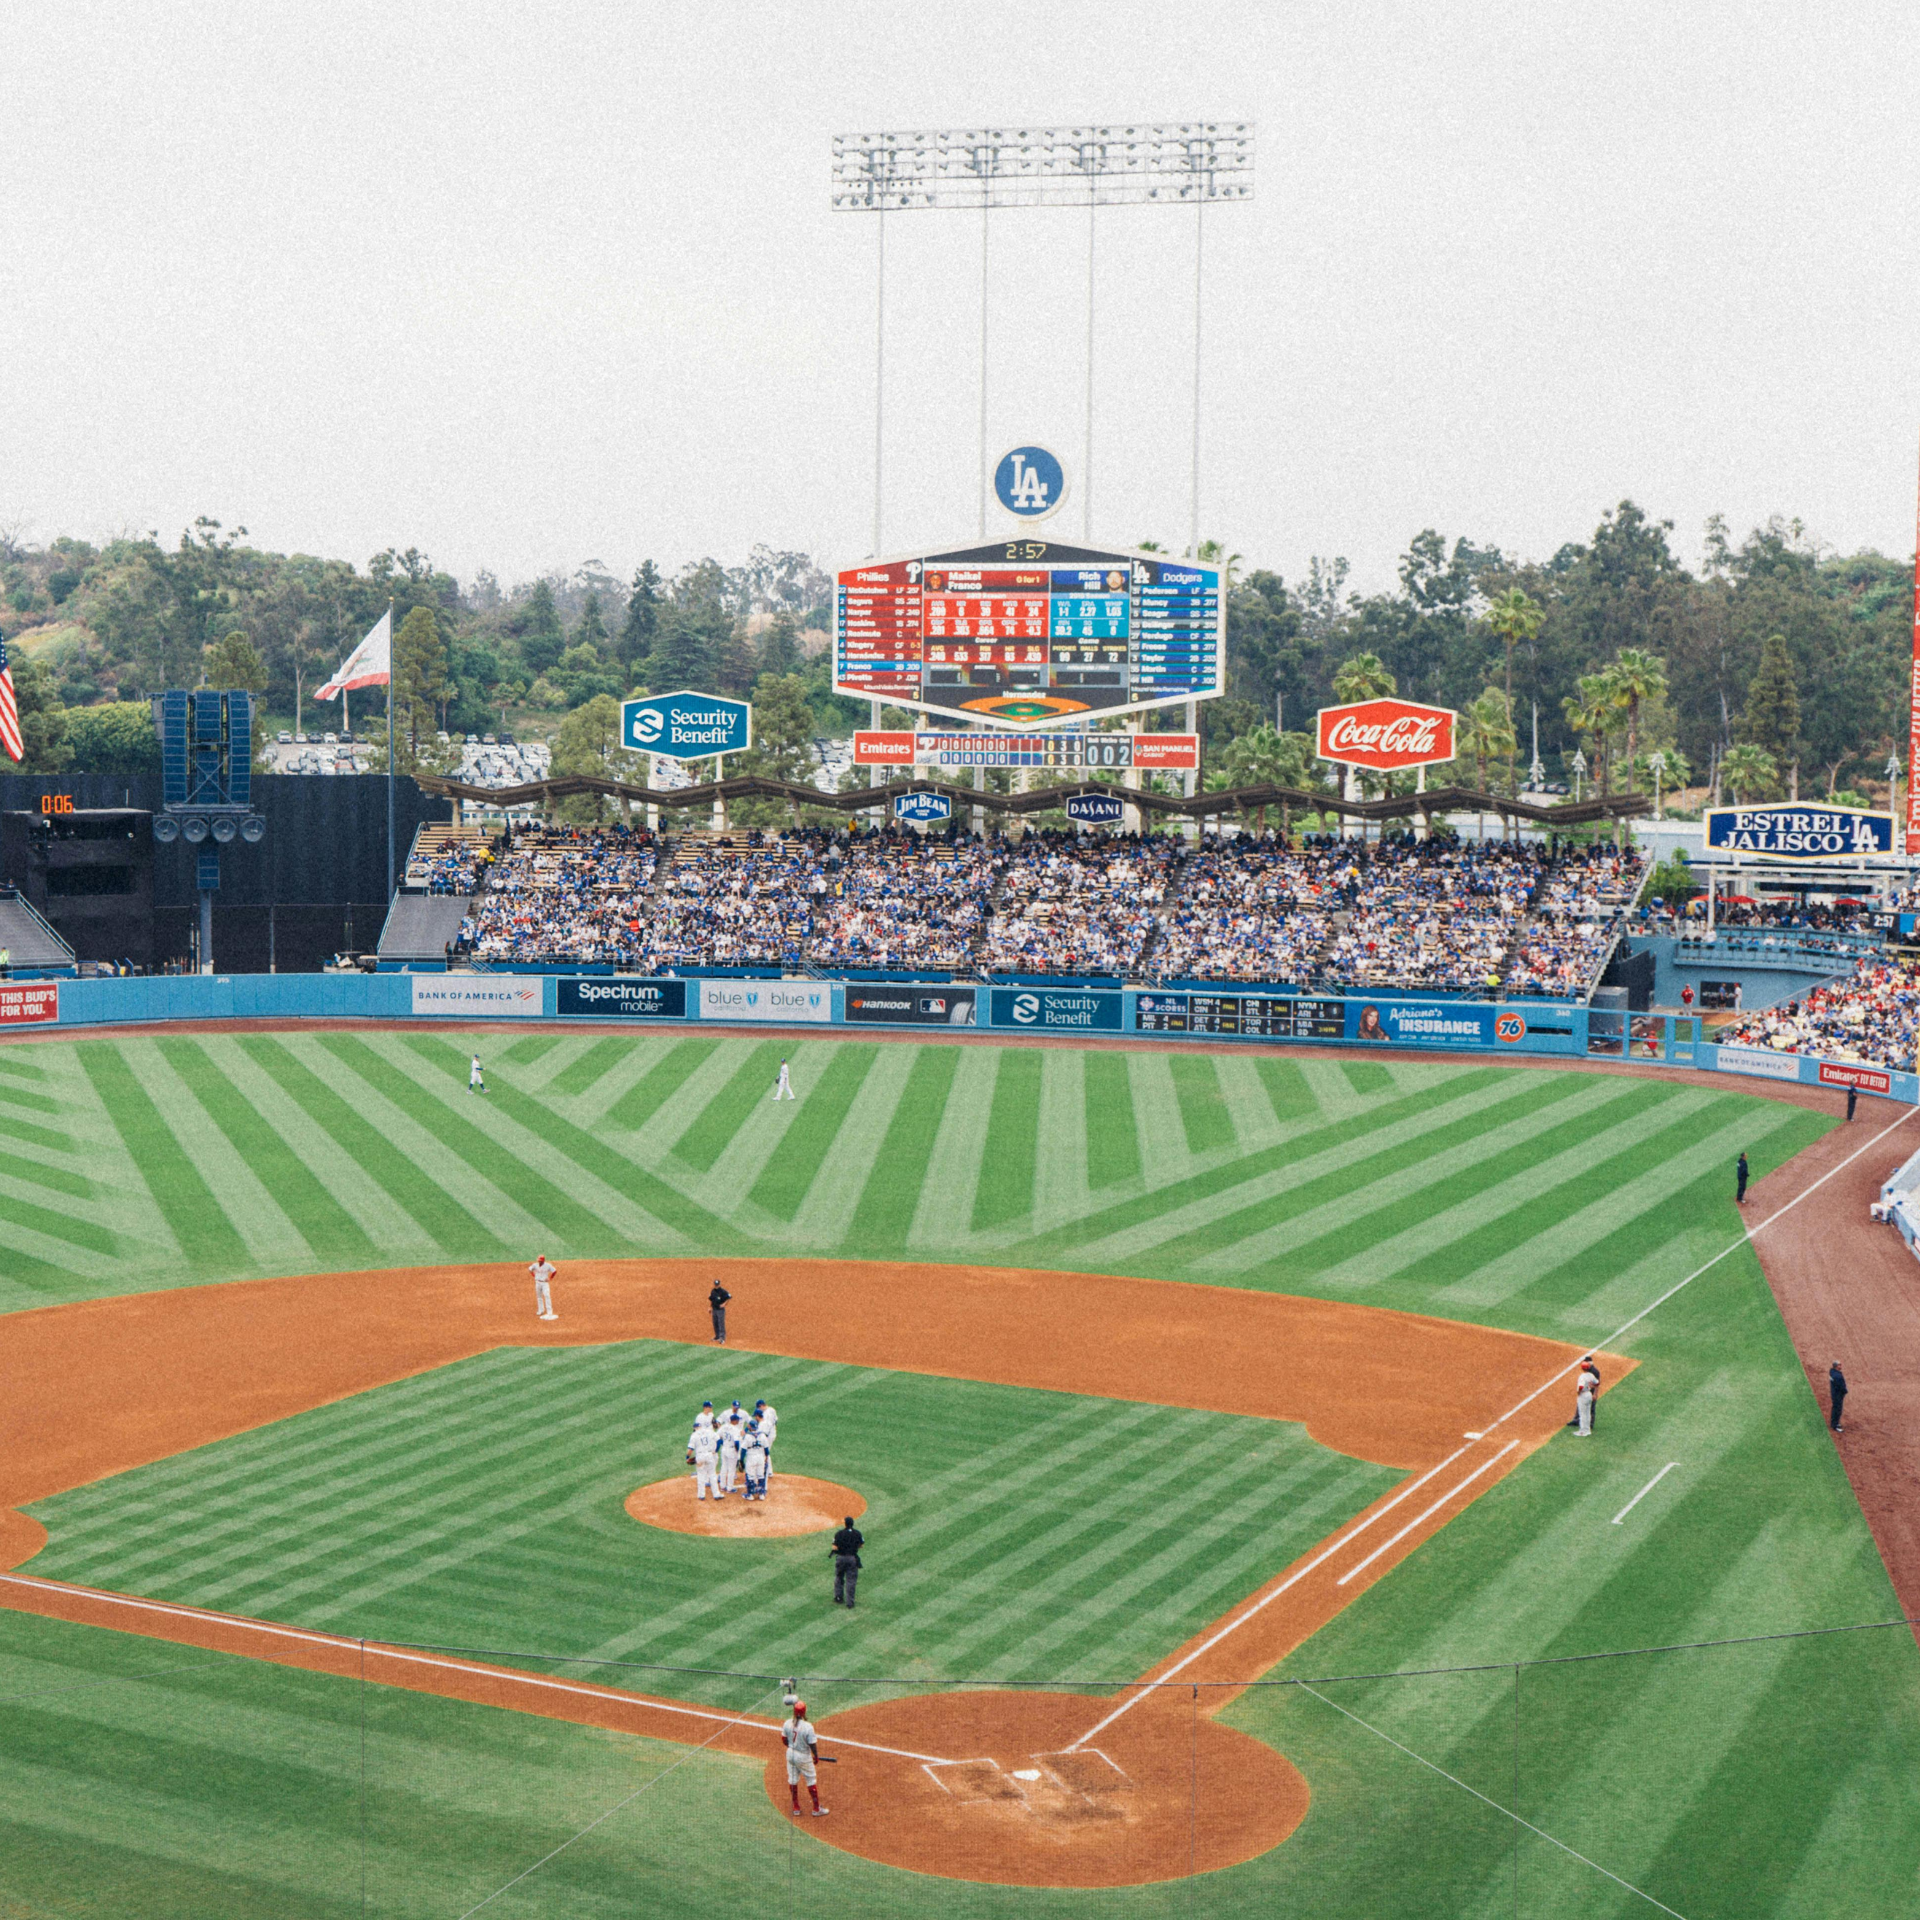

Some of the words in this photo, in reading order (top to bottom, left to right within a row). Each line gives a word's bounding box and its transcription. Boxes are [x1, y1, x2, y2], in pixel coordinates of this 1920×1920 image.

[1006, 544, 1046, 559] 2:57
[857, 572, 889, 581] Phillies
[948, 572, 981, 580] Maikel
[1079, 572, 1100, 580] Rich
[1163, 573, 1202, 584] Dodgers
[948, 581, 982, 590] Franco
[1084, 581, 1100, 589] Hill
[1142, 599, 1168, 607] Muncy
[1084, 652, 1094, 662] 27
[1108, 652, 1118, 662] 72
[671, 709, 737, 729] Security
[671, 727, 728, 743] Benefit
[1328, 716, 1442, 753] Coca-Cola
[860, 742, 910, 754] Emirates
[942, 740, 948, 750] 0
[953, 740, 959, 750] 0
[965, 740, 970, 750] 0
[976, 740, 982, 750] 0
[988, 740, 994, 750] 0
[1000, 740, 1005, 750] 0
[1060, 740, 1066, 751] 3
[942, 753, 948, 763] 0
[953, 753, 959, 763] 0
[965, 753, 970, 763] 0
[976, 753, 982, 763] 0
[988, 753, 994, 763] 0
[999, 753, 1005, 763] 0
[1060, 754, 1066, 764] 3
[1088, 746, 1098, 764] 0
[1104, 746, 1114, 764] 0
[1119, 746, 1129, 765] 2
[42, 795, 73, 813] 0:06
[1071, 801, 1119, 817] DASANI
[1721, 832, 1843, 852] JALISCO
[1874, 915, 1894, 928] 2:57
[1, 992, 23, 1004] THIS
[26, 990, 55, 1002] BUD'S
[579, 983, 658, 1002] Spectrum
[708, 991, 742, 1004] blue
[771, 992, 804, 1005] blue
[1, 1005, 20, 1016] FOR
[22, 1004, 45, 1015] YOU.
[621, 1001, 658, 1011] mobile
[1045, 996, 1100, 1013] Security
[1046, 1011, 1091, 1024] Benefit
[1389, 1007, 1442, 1021] Adriana's
[1399, 1019, 1480, 1034] INSURANCE
[1499, 1019, 1520, 1036] 76
[1824, 1068, 1858, 1083] Emirates
[1860, 1074, 1869, 1085] FLY
[1870, 1075, 1886, 1088] BETTER
[701, 1436, 708, 1446] 13
[792, 1730, 797, 1743] 7
